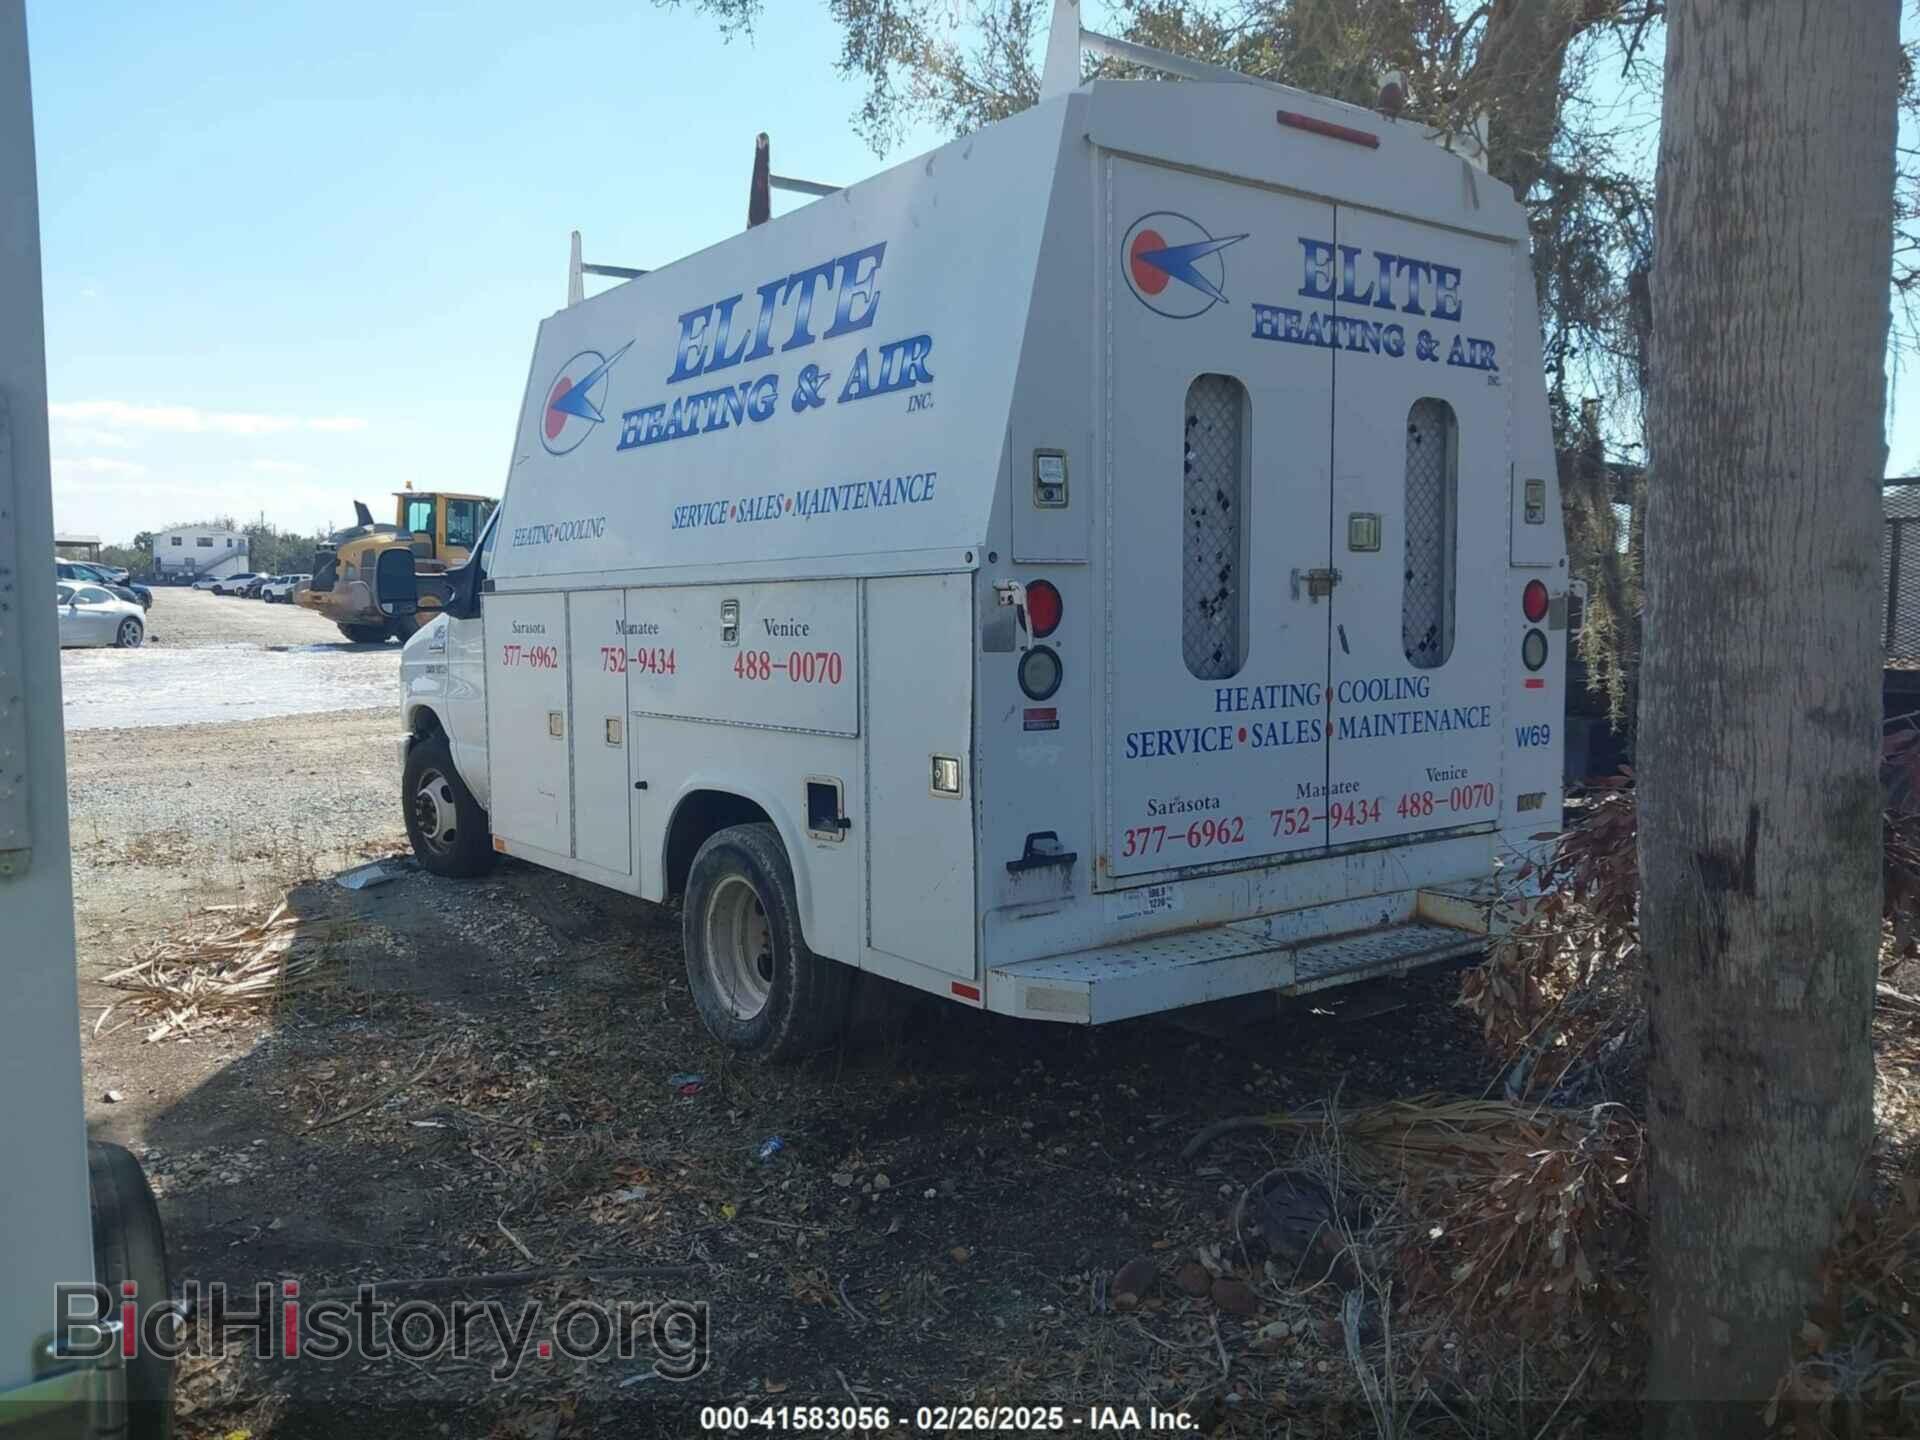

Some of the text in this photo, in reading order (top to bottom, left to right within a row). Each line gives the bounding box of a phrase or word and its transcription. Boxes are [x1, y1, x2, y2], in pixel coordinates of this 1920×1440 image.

[1297, 237, 1462, 322] ELITE
[666, 240, 888, 385] ELITE
[1251, 303, 1499, 371] HEATING & AIR
[615, 334, 934, 452] HEATING & AIR
[906, 393, 934, 413] INC.
[791, 472, 937, 518] MAINTENANCE
[511, 620, 546, 635] Sarasota
[615, 619, 659, 636] Manatee
[763, 618, 810, 637] Venice
[502, 644, 558, 669] 377-6962
[600, 646, 676, 675] 752-9434
[733, 650, 843, 685] 488-0070
[1214, 675, 1431, 713] HEATING COOLING
[1125, 705, 1491, 760] SERVICE SALES MAINTENANCE
[1514, 724, 1551, 748] W69
[1296, 778, 1360, 801] Manatee
[1425, 765, 1469, 783] Venice
[1147, 795, 1221, 817] Sarasota
[1270, 798, 1382, 838] 752-9434
[1396, 782, 1495, 819] 488-0070
[1121, 816, 1246, 858] 377-6962
